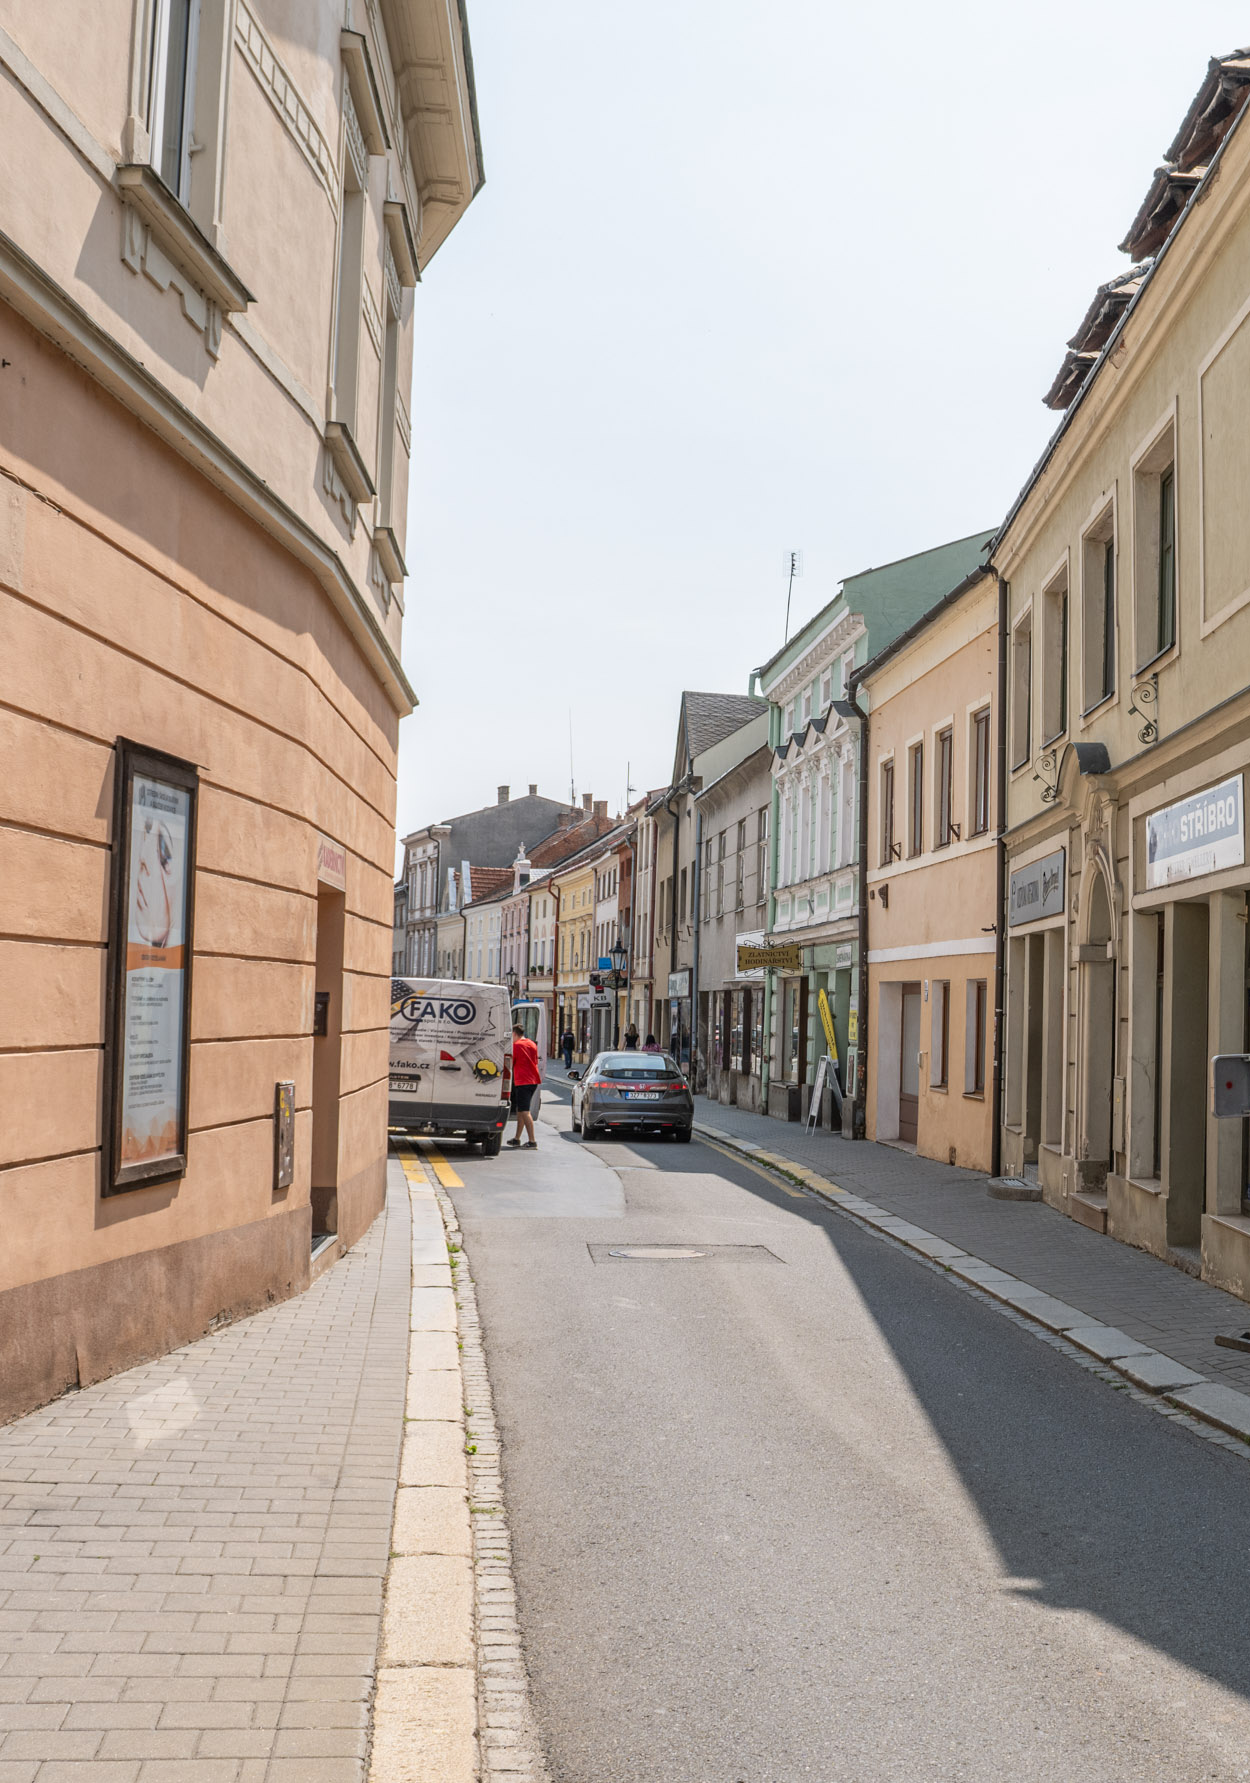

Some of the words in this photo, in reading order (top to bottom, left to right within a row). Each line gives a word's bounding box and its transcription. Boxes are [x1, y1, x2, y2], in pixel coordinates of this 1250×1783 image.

[1180, 795, 1235, 843] STŘÍBRO
[745, 957, 793, 965] HODINÁŘSTVÍ
[410, 1000, 471, 1022] FAKO
